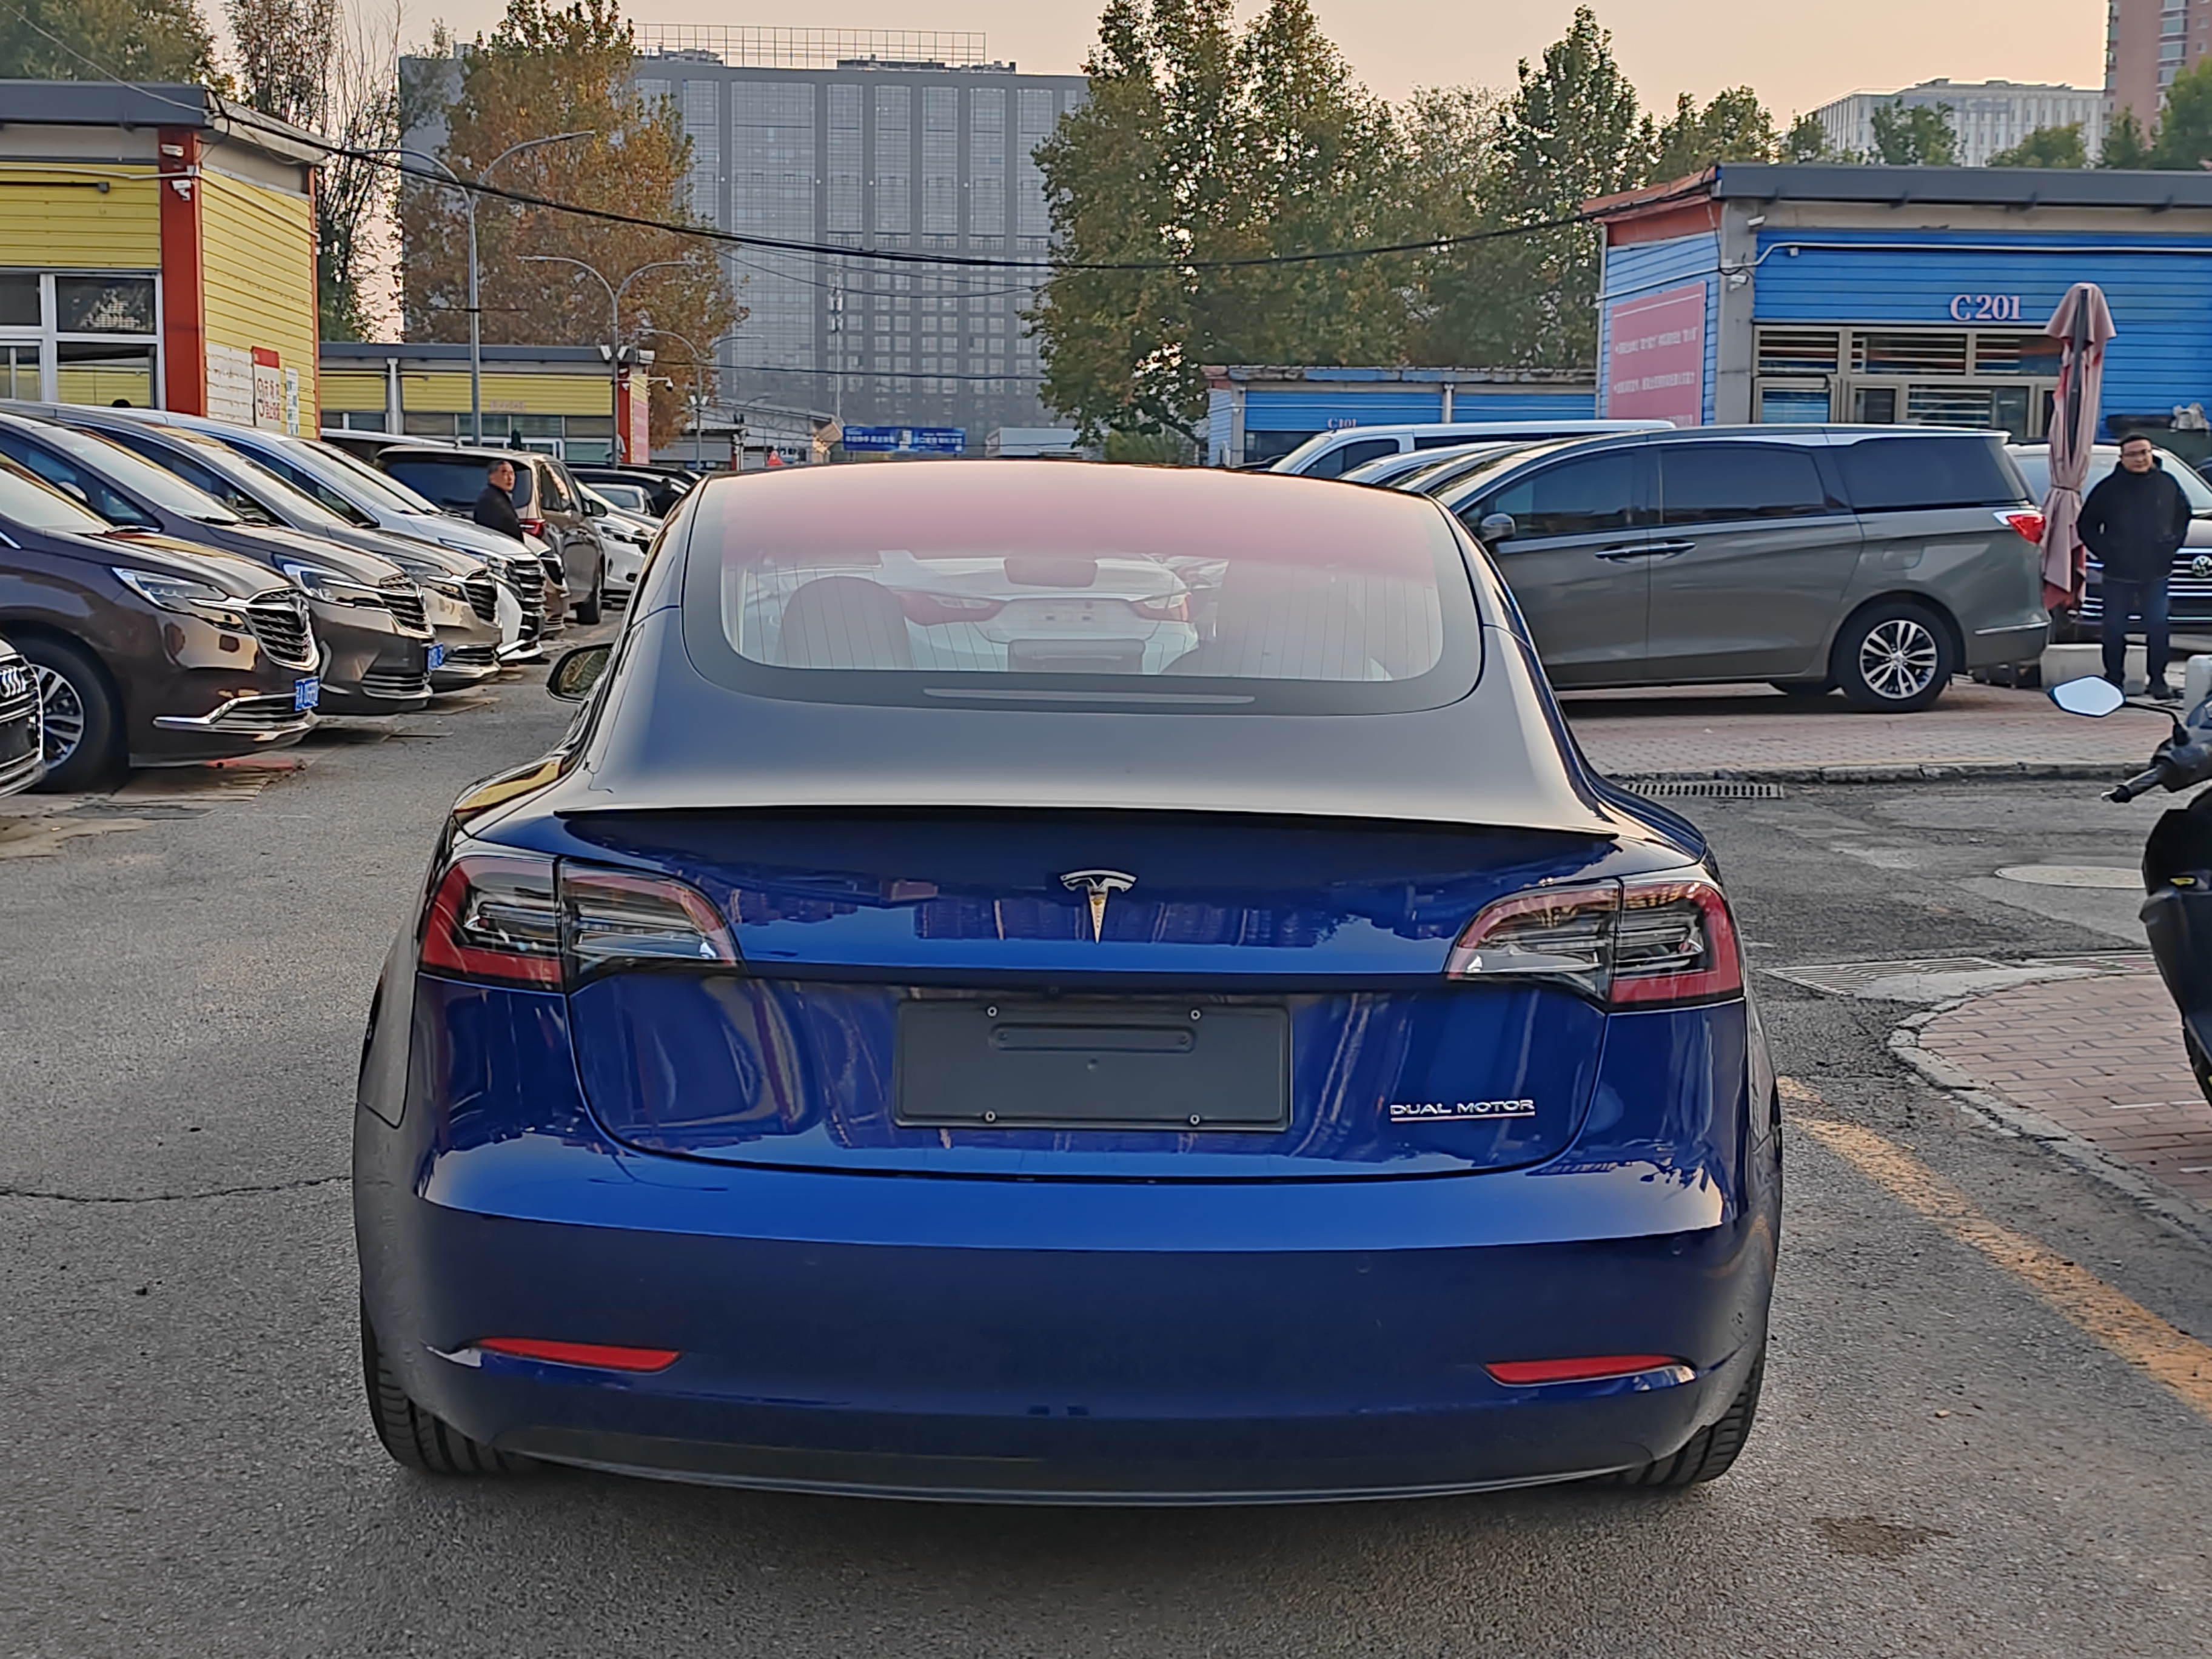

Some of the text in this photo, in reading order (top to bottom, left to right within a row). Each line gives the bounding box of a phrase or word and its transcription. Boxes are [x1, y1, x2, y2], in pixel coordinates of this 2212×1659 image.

[1950, 294, 2022, 321] C201
[1390, 1099, 1535, 1115] DUAL MOTOR
